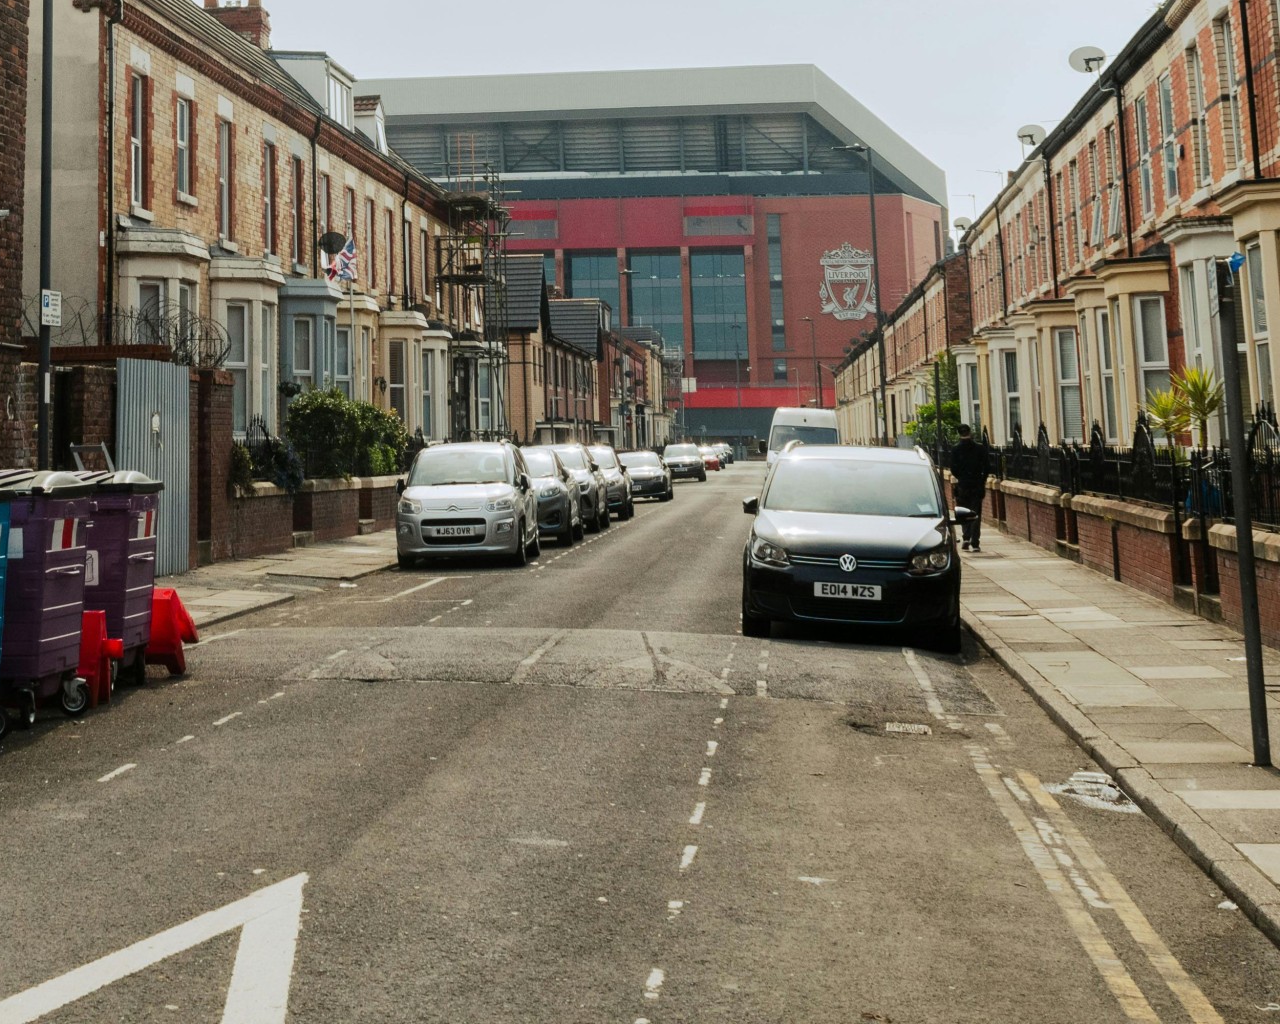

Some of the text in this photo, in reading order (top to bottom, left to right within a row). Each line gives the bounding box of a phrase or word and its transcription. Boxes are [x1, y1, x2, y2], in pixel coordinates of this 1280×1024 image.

[828, 271, 868, 279] LIVERPOOL
[436, 527, 471, 535] WJ63 OVR
[821, 583, 875, 598] EO14 WZS
